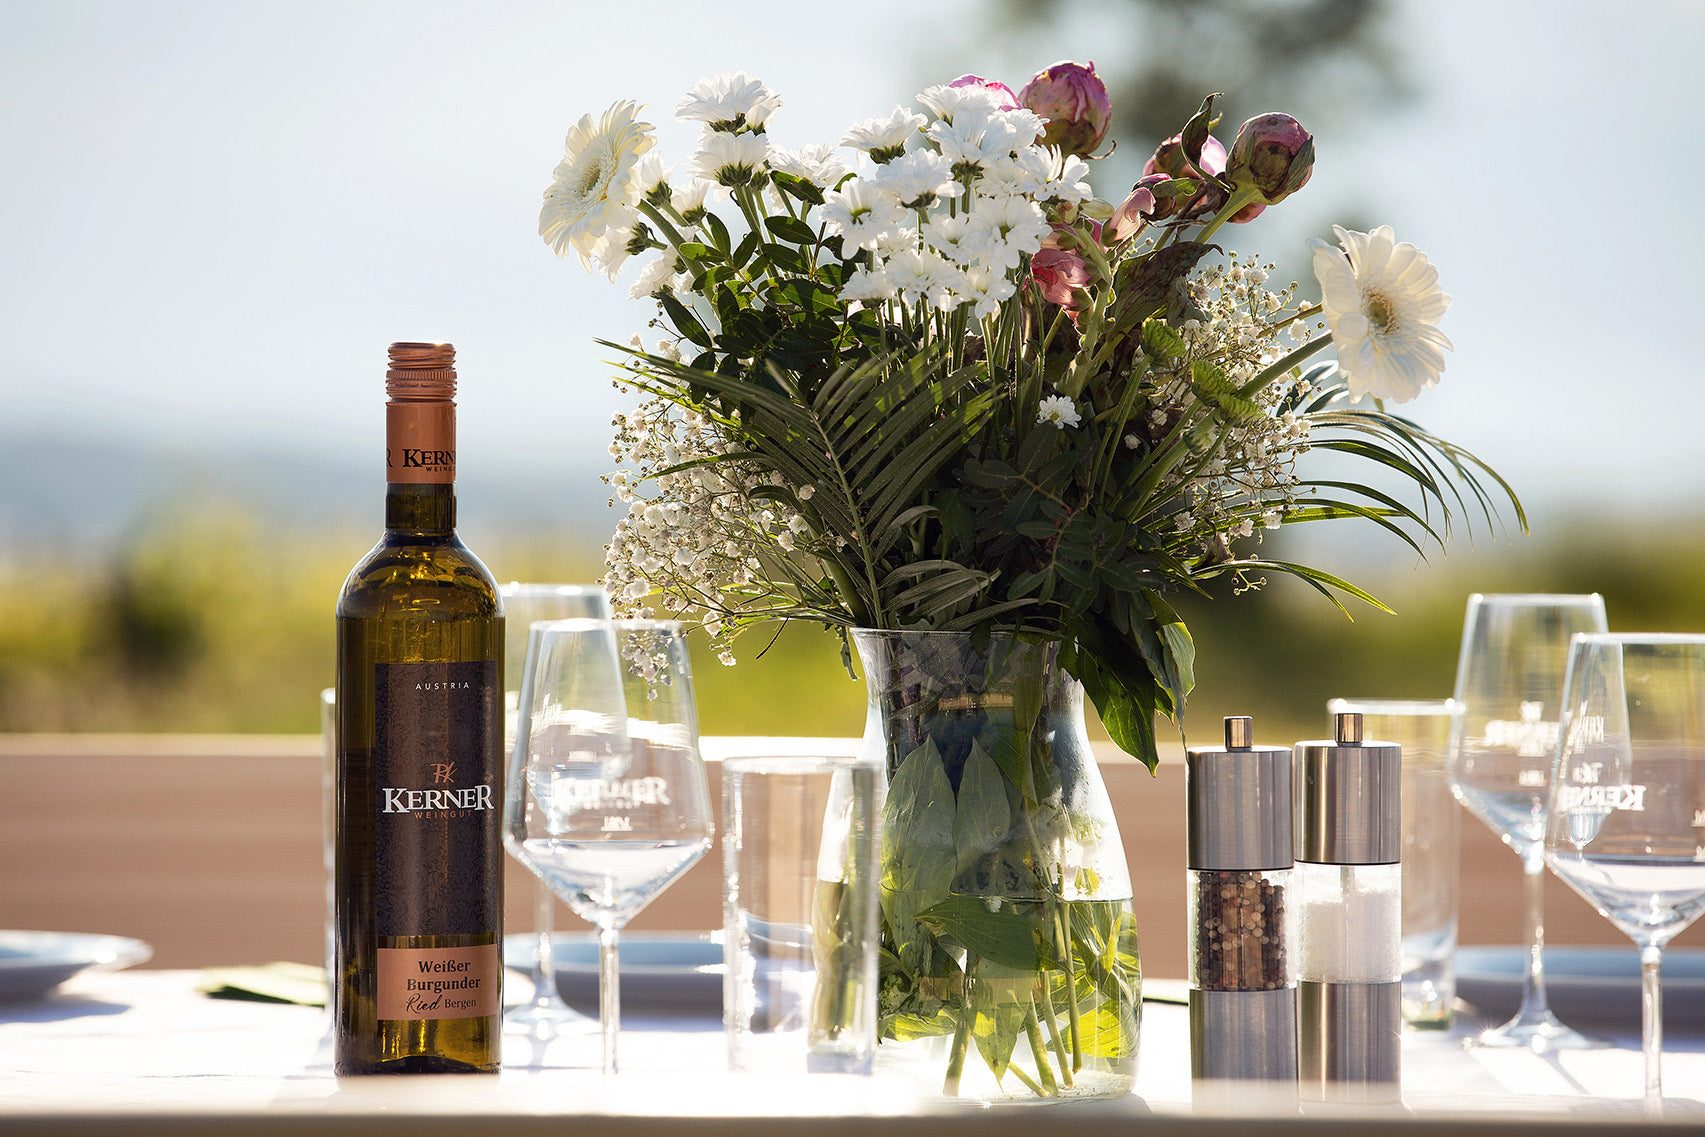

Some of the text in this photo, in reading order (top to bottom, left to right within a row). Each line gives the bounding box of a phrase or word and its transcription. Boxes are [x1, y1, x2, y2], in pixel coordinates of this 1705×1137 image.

[415, 682, 470, 690] AUSTRIA
[382, 785, 494, 813] KERNER
[414, 810, 472, 819] WEINGUT
[419, 960, 471, 973] Weißer
[407, 977, 481, 993] Burgunder
[406, 993, 476, 1014] Ried Bergen
